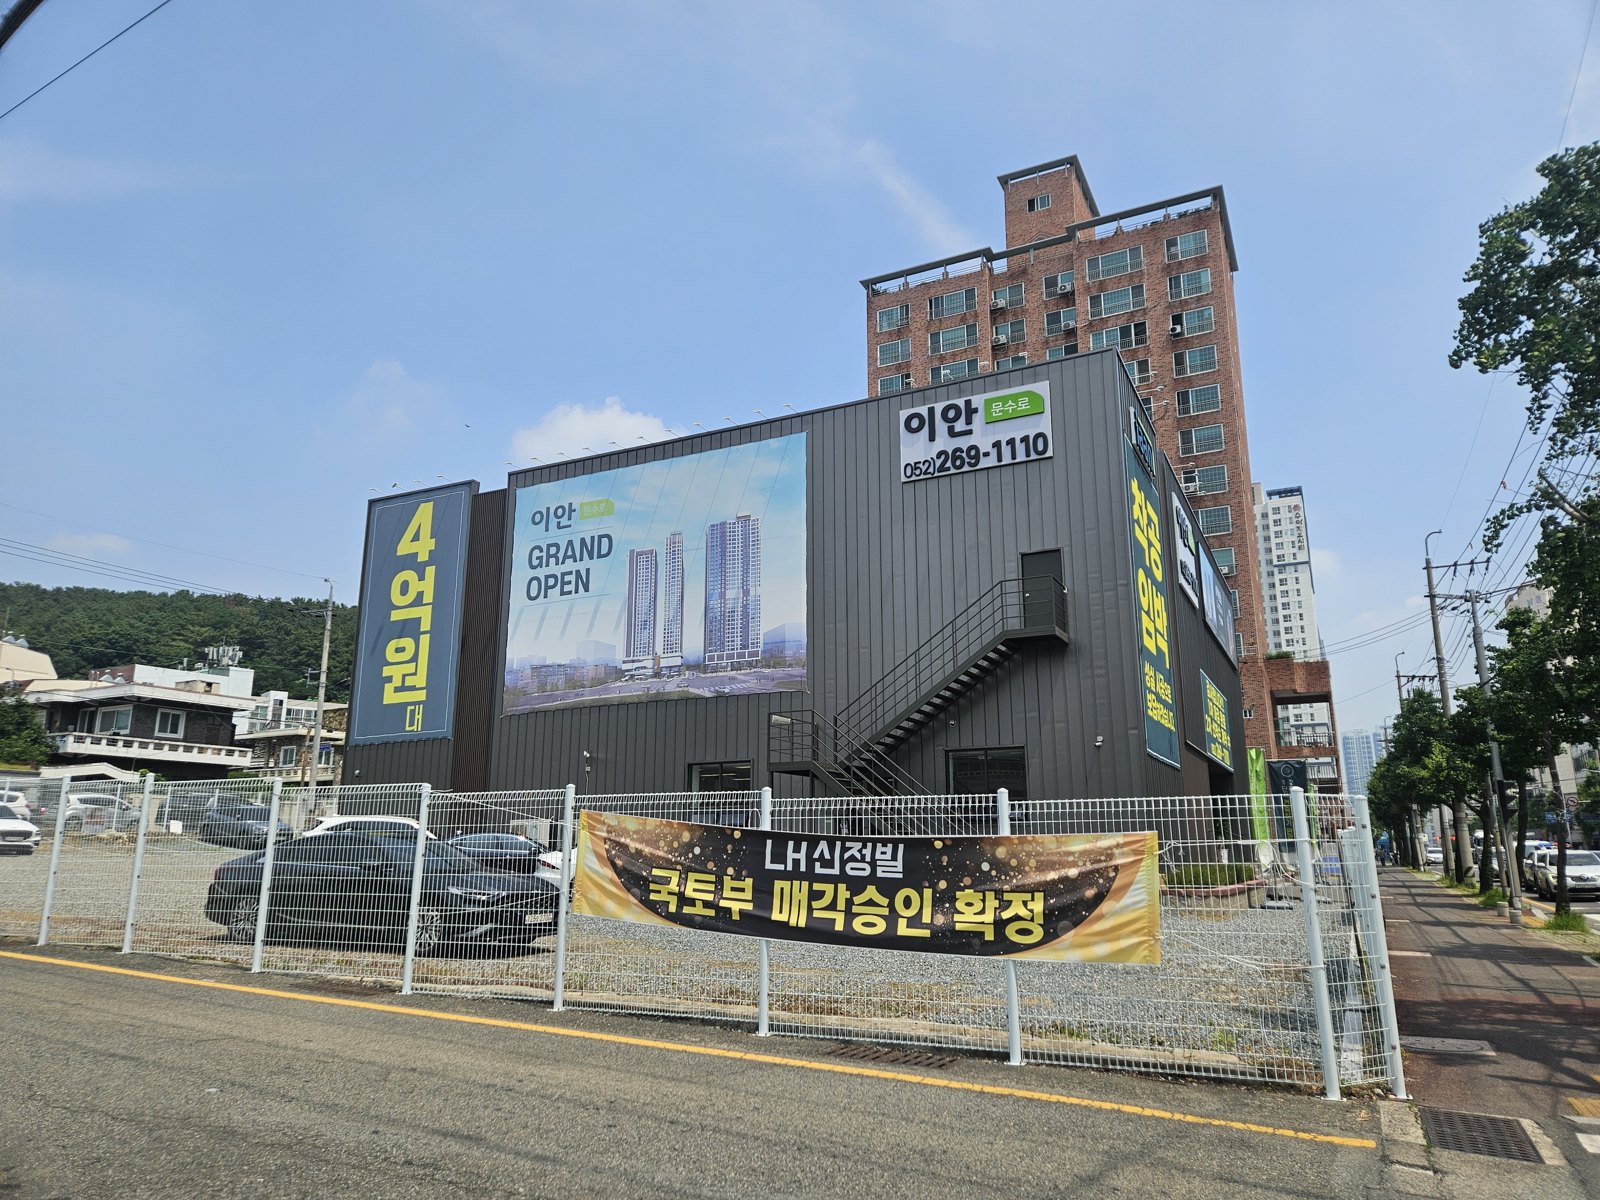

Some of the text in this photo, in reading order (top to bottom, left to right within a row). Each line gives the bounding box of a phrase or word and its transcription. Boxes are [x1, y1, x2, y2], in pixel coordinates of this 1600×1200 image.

[904, 397, 1031, 442] 이안 문수로
[904, 432, 1049, 479] 052)269-1110
[531, 502, 576, 532] 이안
[1131, 477, 1163, 582] 착공
[527, 533, 614, 570] GRAND
[526, 568, 591, 601] OPEN
[382, 501, 436, 732] 4억원대
[1138, 567, 1170, 669] 임박
[649, 867, 1045, 944] 국토부 매각승인 확정
